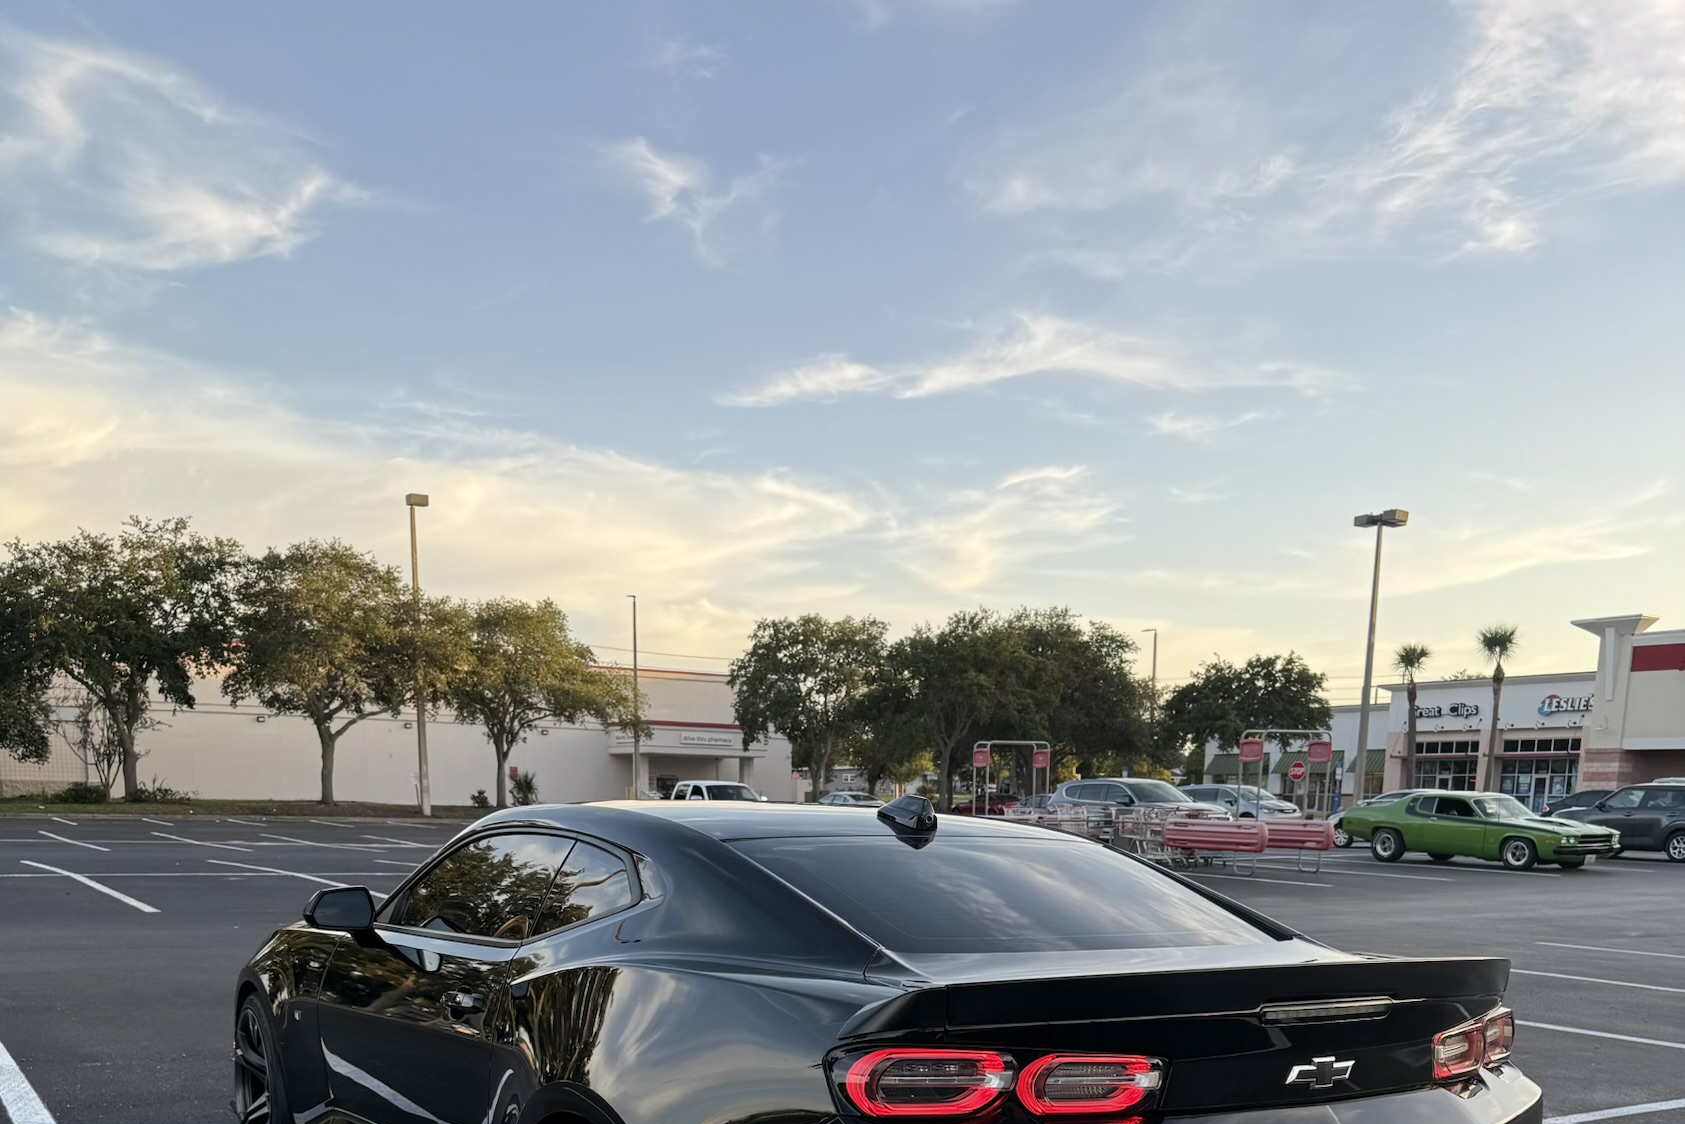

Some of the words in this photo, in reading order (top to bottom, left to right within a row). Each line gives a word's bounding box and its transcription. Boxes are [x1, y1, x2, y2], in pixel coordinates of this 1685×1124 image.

[1414, 705, 1441, 717] reat
[1447, 703, 1479, 719] Clips
[1289, 767, 1305, 776] STOP
